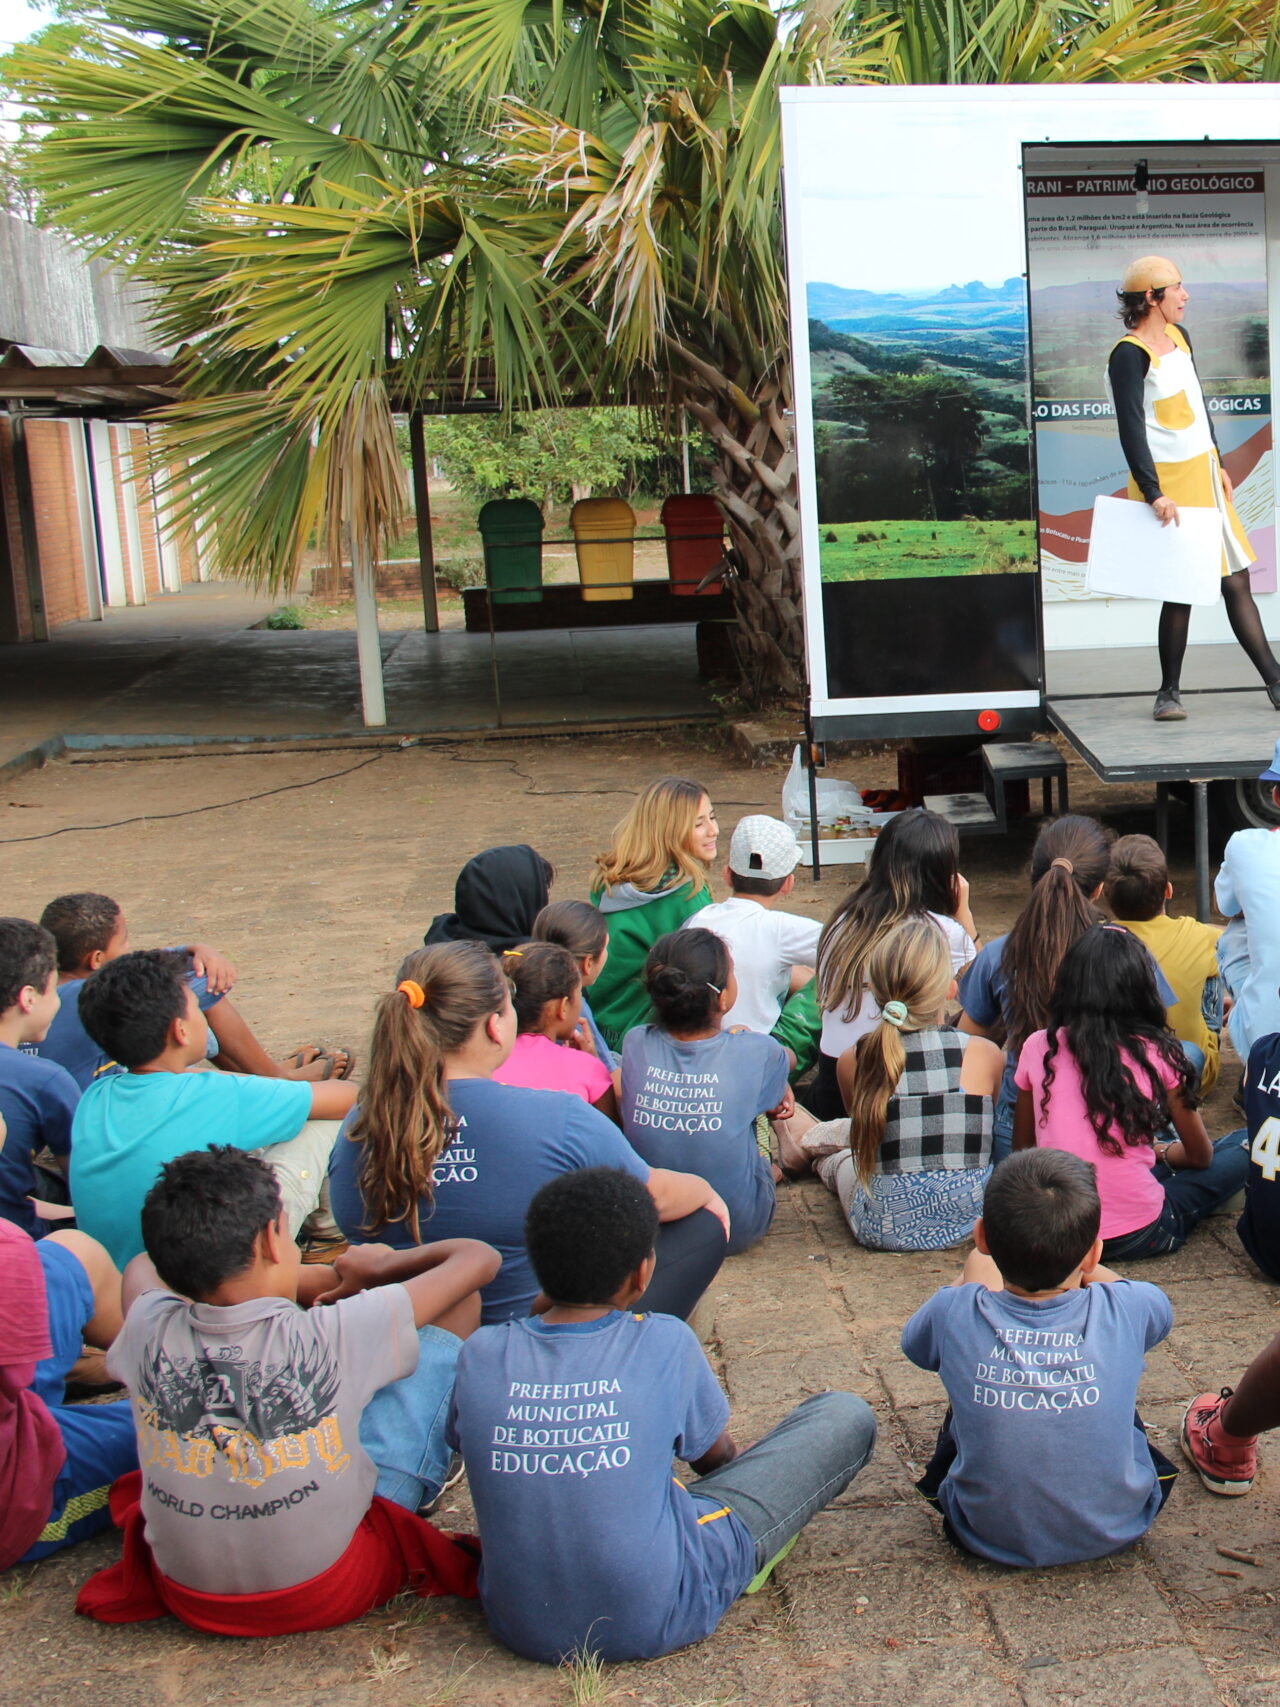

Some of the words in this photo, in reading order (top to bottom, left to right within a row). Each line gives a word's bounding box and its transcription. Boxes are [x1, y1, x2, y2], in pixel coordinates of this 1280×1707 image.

[1027, 180, 1062, 193] RANI
[1171, 175, 1255, 191] GEOLÓGICO
[1056, 214, 1065, 222] de
[1076, 214, 1102, 222] milhões
[1200, 210, 1231, 220] Geológica
[1031, 224, 1048, 232] parte
[1048, 223, 1057, 231] do
[1051, 404, 1080, 417] DAS
[1083, 403, 1115, 416] FOR
[1207, 396, 1262, 412] ÓGICAS
[1045, 528, 1071, 541] Botucatu
[646, 1065, 719, 1085] PREFEITURA
[643, 1081, 717, 1099] MUNICIPAL
[635, 1093, 650, 1108] DE
[653, 1099, 723, 1113] BOTUCATU
[633, 1109, 722, 1136] EDUCAÇÃO
[995, 1328, 1085, 1347] REFEITURA
[990, 1345, 1083, 1366] MUNICIPAL
[977, 1362, 997, 1380] DE
[1002, 1363, 1096, 1385] BOTUCATU
[509, 1377, 622, 1400] PREFEITURA
[973, 1385, 1100, 1415] EDUCAÇÃO
[507, 1400, 619, 1422] MUNICIPAL
[493, 1425, 517, 1443] DE
[523, 1421, 631, 1446] BOTUCATU
[491, 1445, 632, 1479] EDUCAÇÃO
[147, 1476, 204, 1517] WORLD
[210, 1479, 320, 1520] CHAMPION
